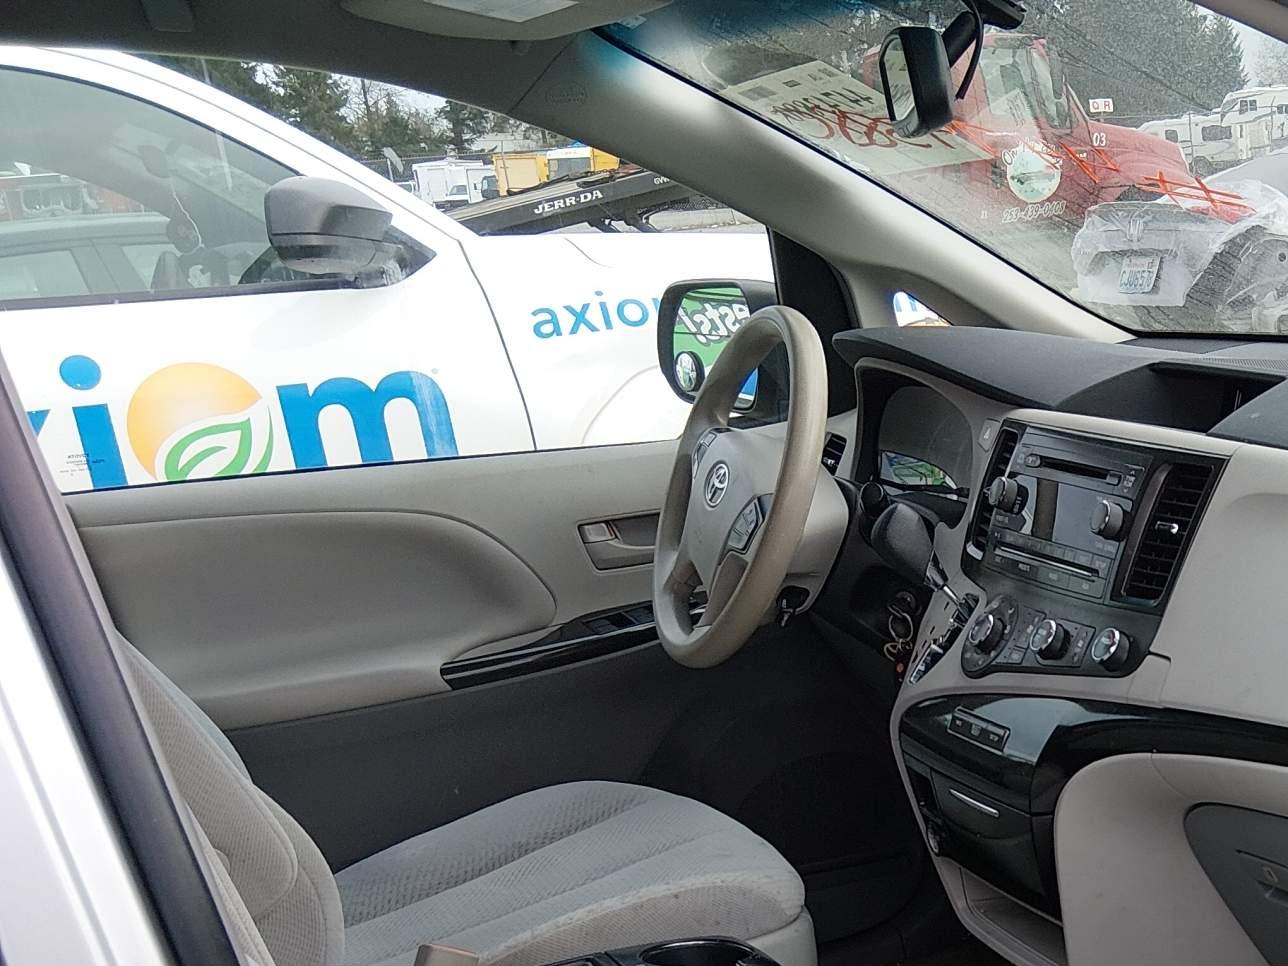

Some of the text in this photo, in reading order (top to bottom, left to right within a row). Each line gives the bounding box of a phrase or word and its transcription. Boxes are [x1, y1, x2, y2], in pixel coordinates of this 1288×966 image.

[1092, 132, 1106, 147] 03
[533, 189, 603, 215] JERR-DA
[531, 290, 661, 339] axio
